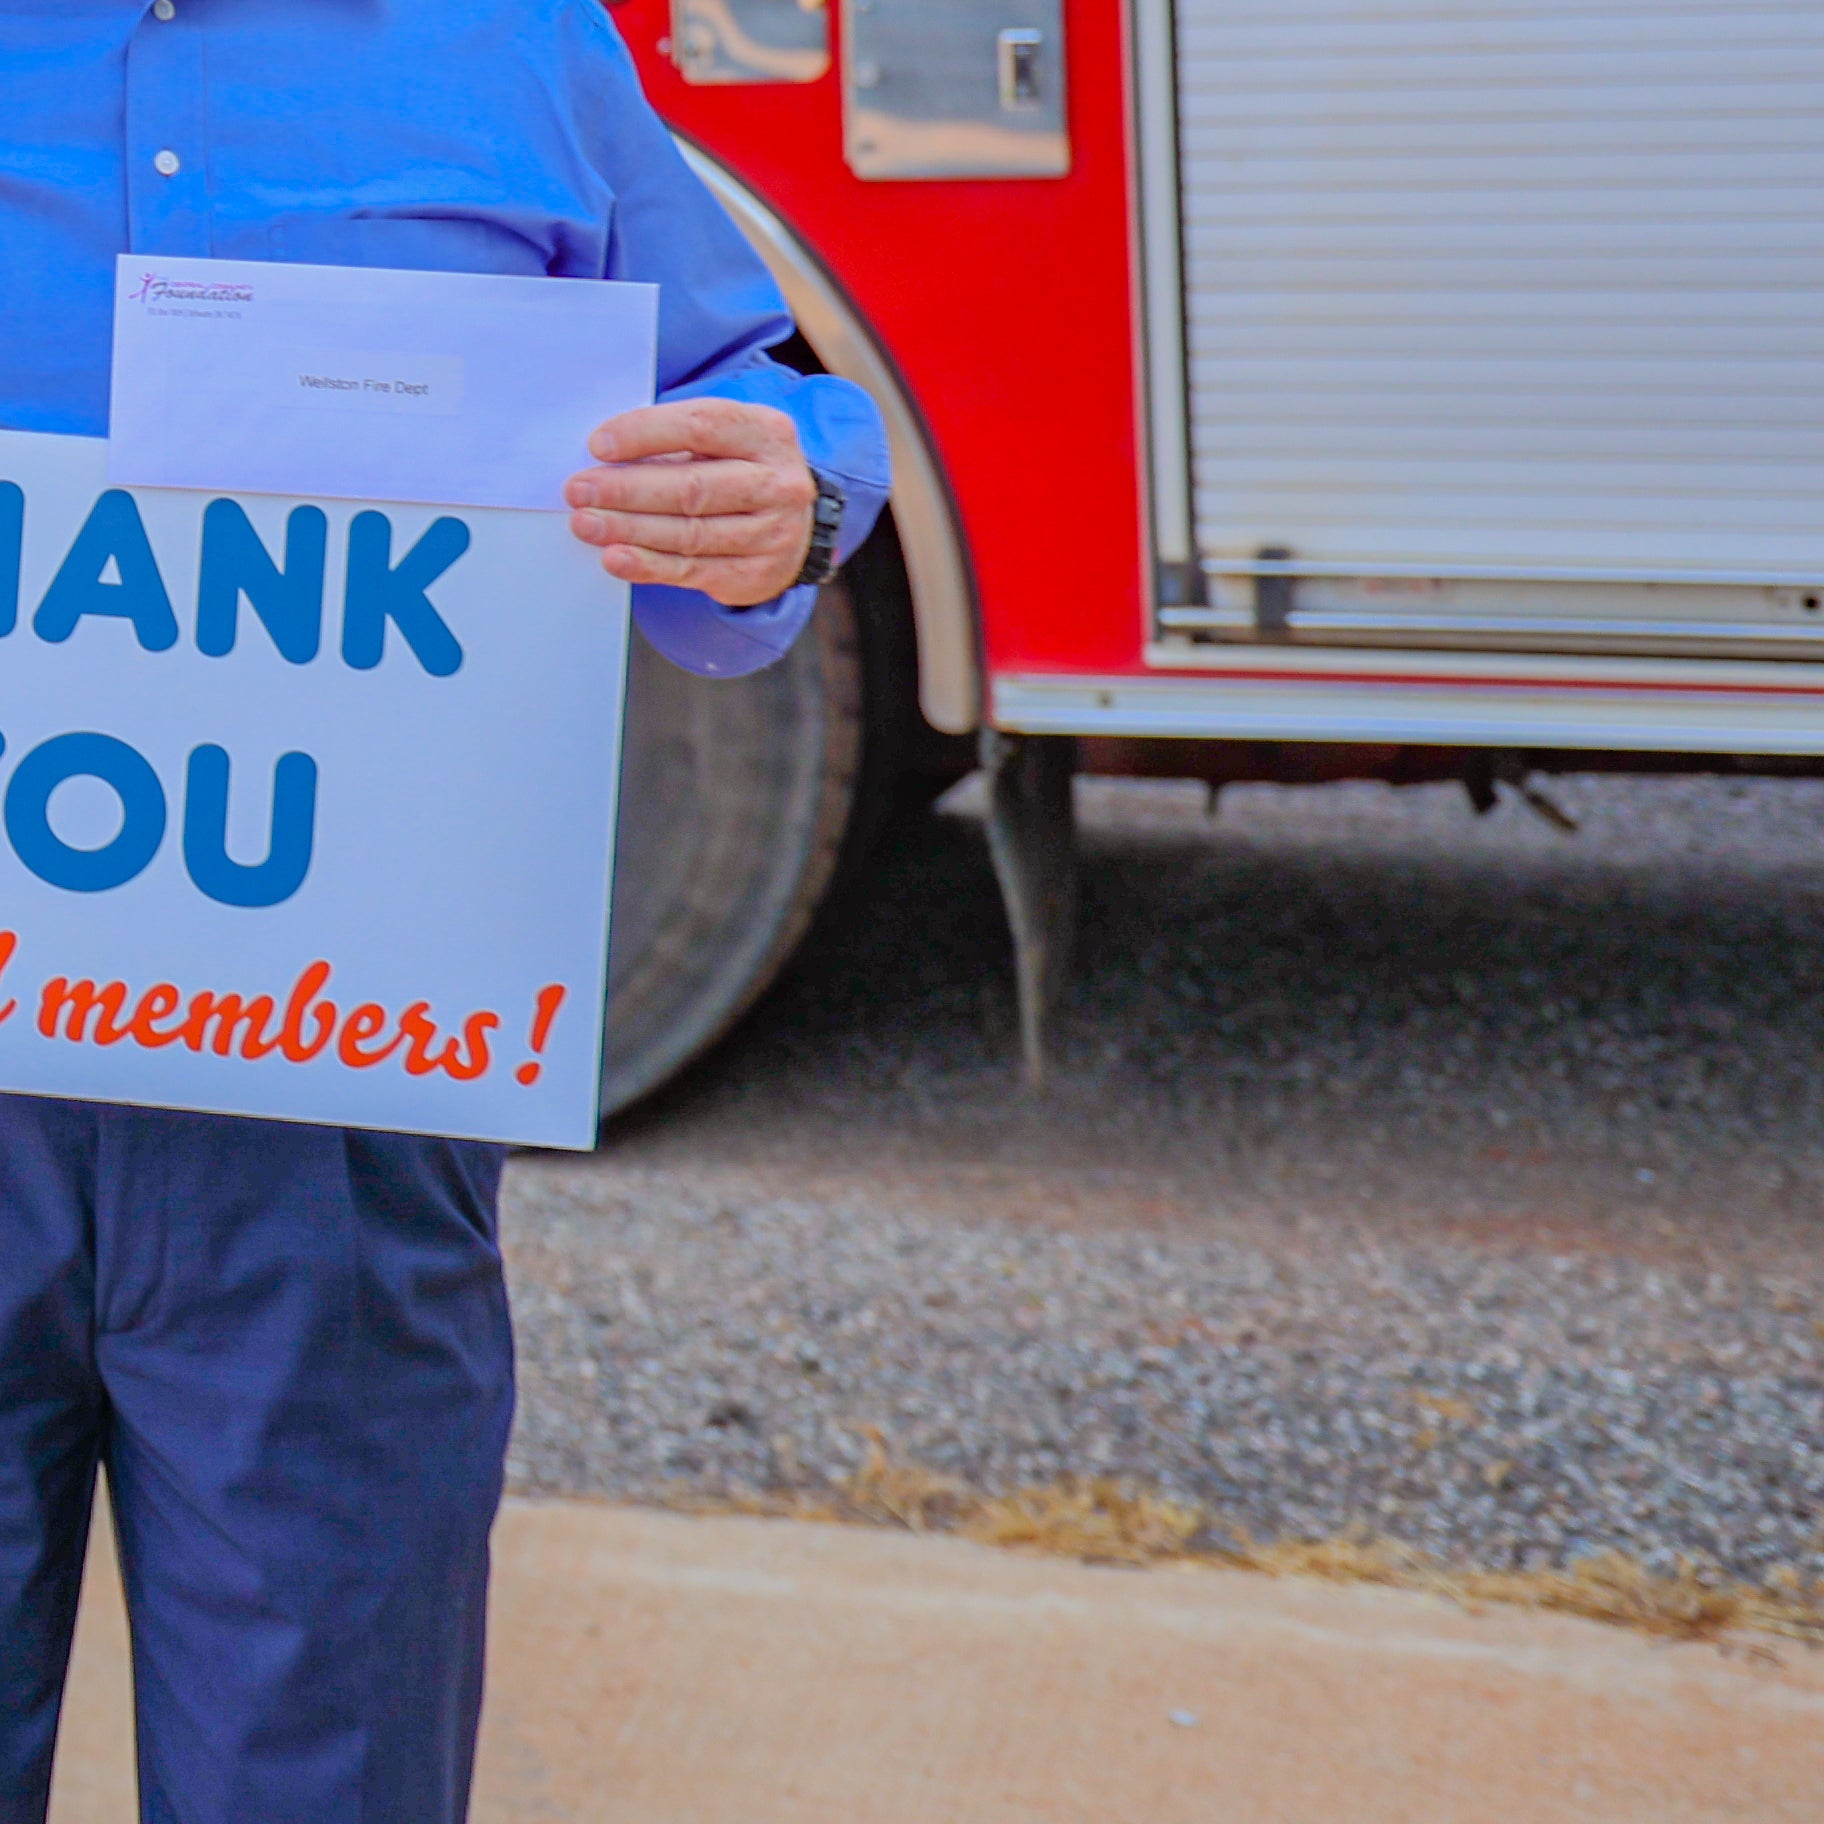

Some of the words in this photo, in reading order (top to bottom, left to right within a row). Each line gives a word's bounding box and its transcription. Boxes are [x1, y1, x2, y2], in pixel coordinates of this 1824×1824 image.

[298, 374, 359, 391] Wellston
[363, 378, 390, 394] Fire
[394, 379, 429, 397] Dept
